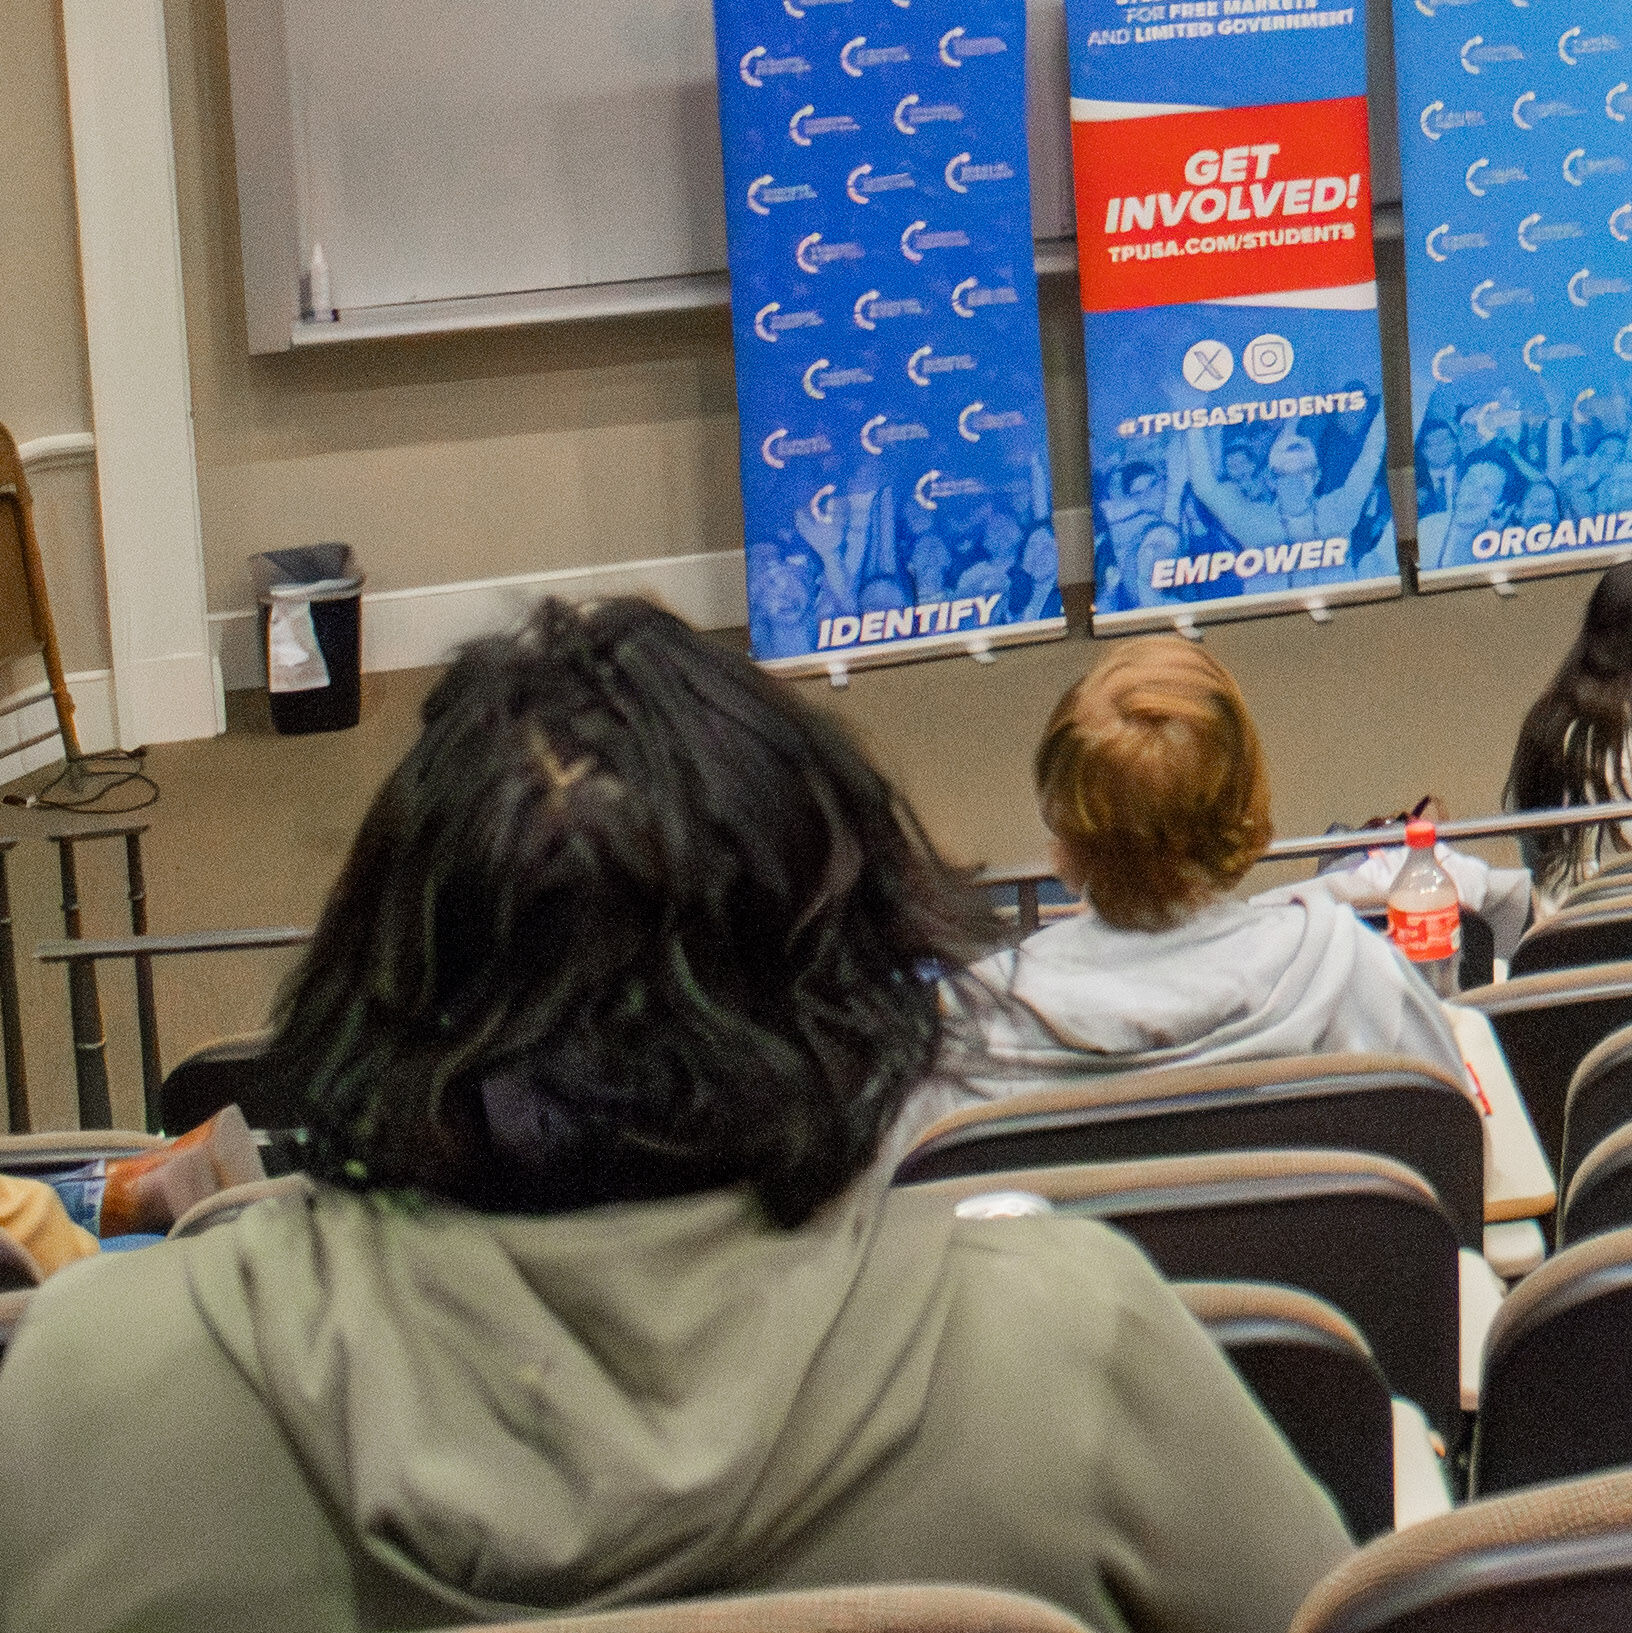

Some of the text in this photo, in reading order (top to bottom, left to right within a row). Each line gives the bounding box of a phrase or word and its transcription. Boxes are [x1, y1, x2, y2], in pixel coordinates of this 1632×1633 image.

[1087, 8, 1355, 47] AND LIMITED GOVERNMENT
[1126, 5, 1166, 24] FOR
[1168, 1, 1219, 20] FREE
[1184, 142, 1281, 186] GET
[1104, 173, 1361, 234] INVOLVED!
[1107, 222, 1356, 263] TPUSA.COM/STUDENTS
[1117, 390, 1368, 438] @TPUSASTUDENTS
[1150, 537, 1350, 590] EMPOWER
[816, 593, 1002, 650] IDENTIFY
